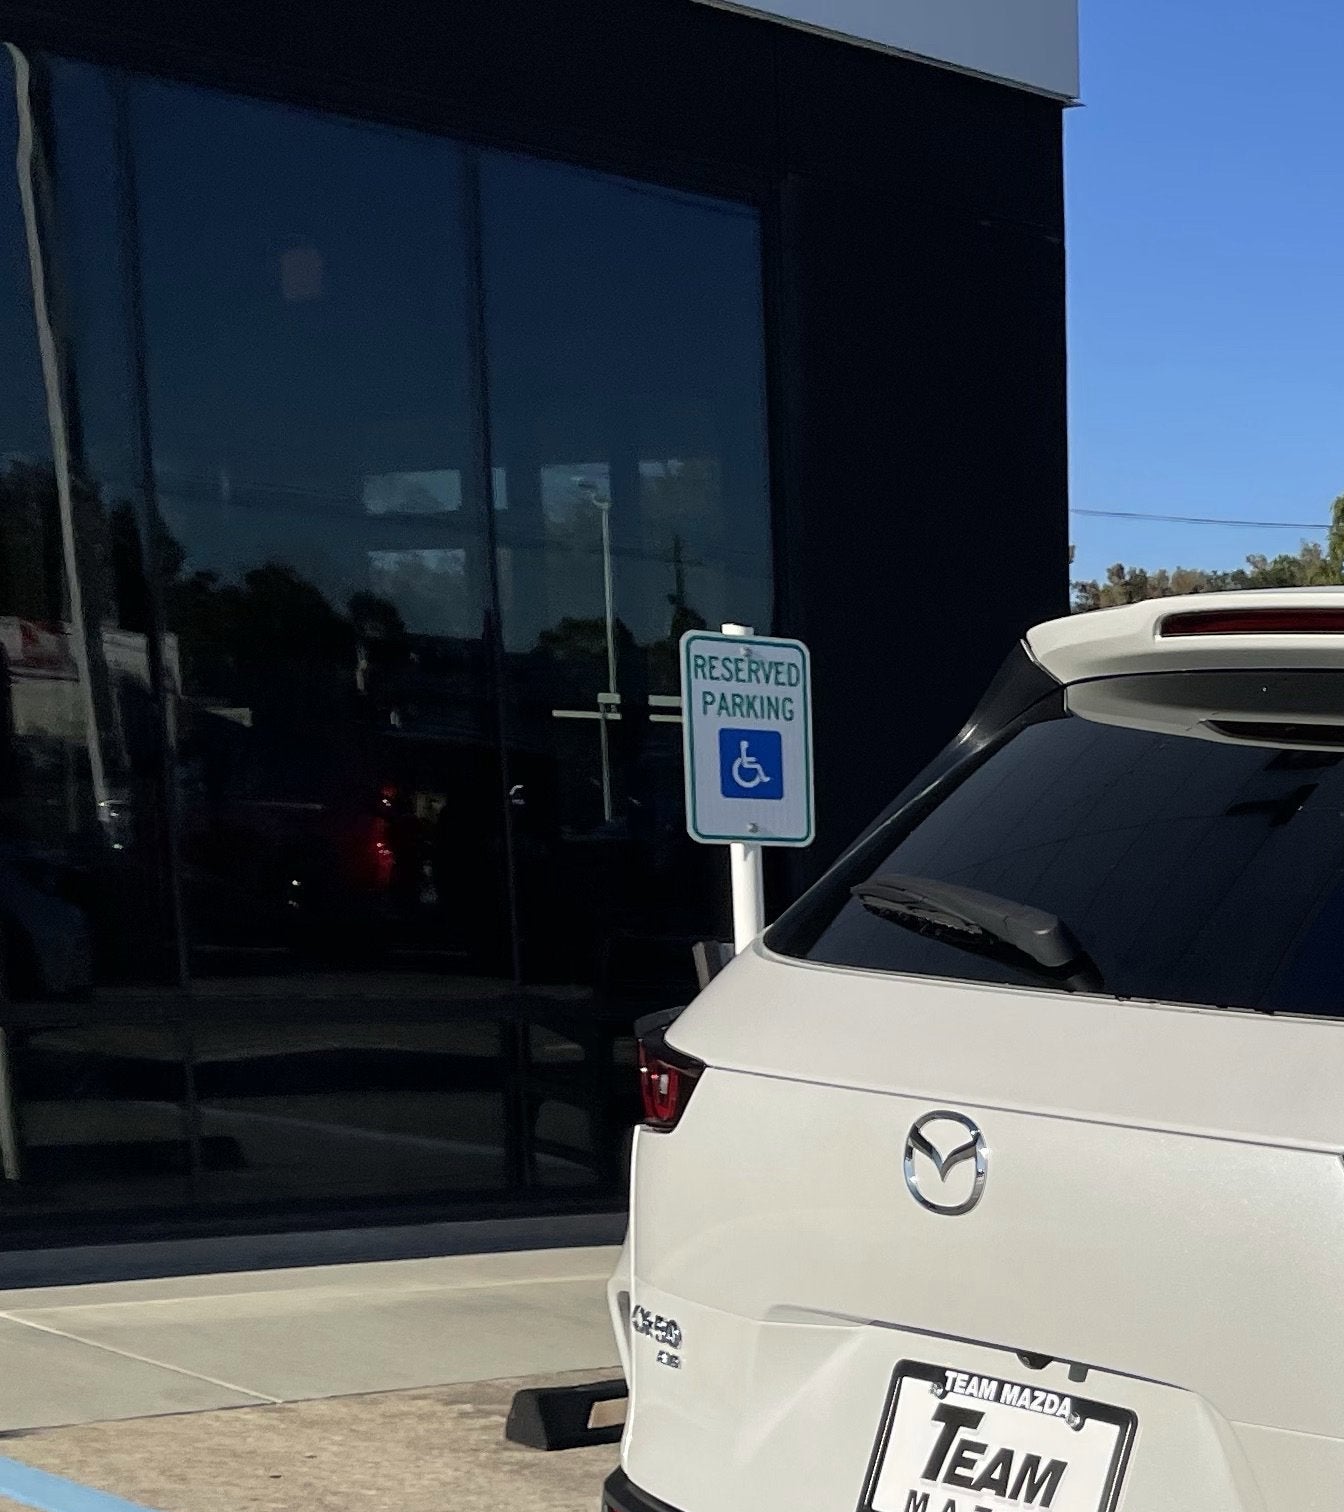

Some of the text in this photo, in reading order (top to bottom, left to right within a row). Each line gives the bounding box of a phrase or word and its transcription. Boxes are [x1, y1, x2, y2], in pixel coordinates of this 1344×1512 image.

[694, 655, 800, 687] RESERVED
[702, 691, 794, 721] PARKING
[944, 1371, 1072, 1419] TEAM MAZDA
[921, 1402, 1068, 1508] TEAM
